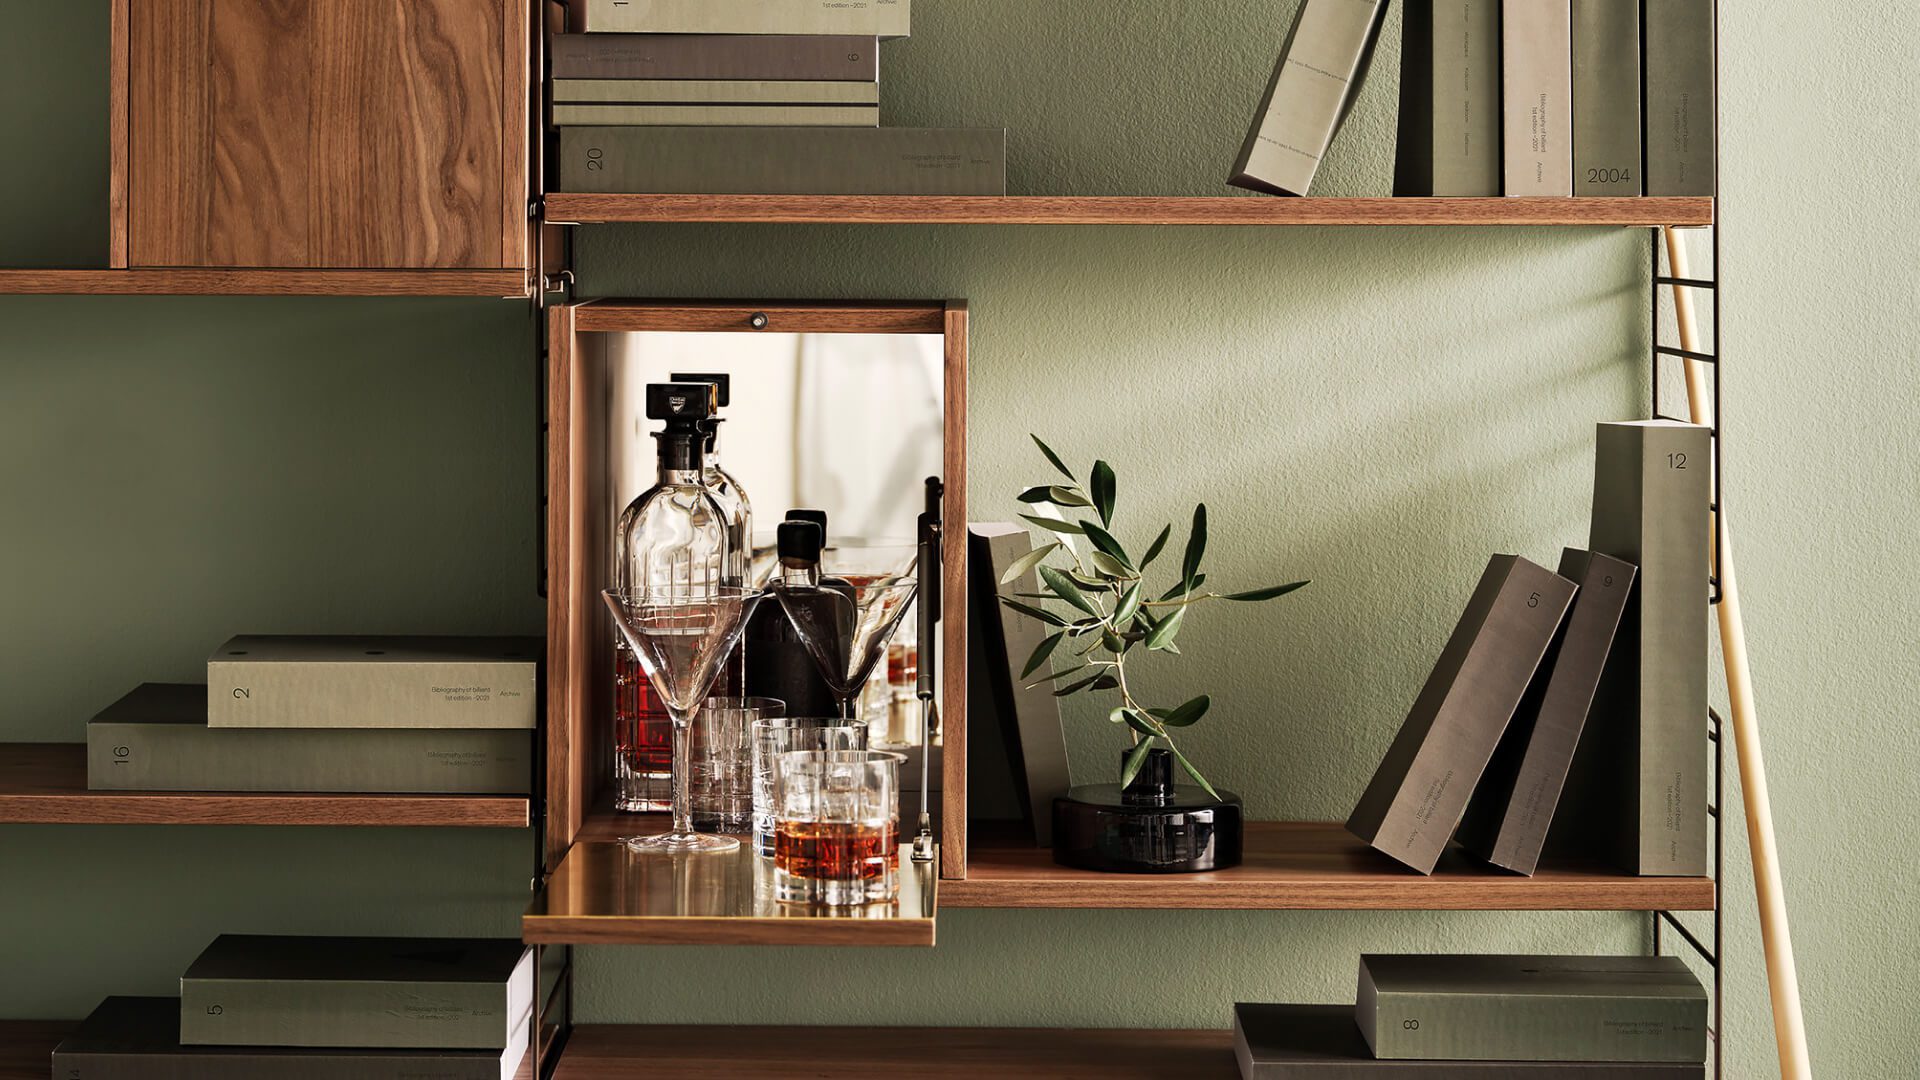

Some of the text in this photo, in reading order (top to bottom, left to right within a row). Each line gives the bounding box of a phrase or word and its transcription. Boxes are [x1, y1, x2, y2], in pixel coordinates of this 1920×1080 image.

[587, 147, 603, 171] 20
[1587, 168, 1631, 183] 2004
[1667, 453, 1687, 470] 12
[1603, 575, 1613, 587] 9
[1527, 592, 1541, 608] 5
[233, 687, 250, 699] 2
[113, 746, 130, 766] 16
[207, 1004, 223, 1015] 5
[1403, 1019, 1419, 1030] 8
